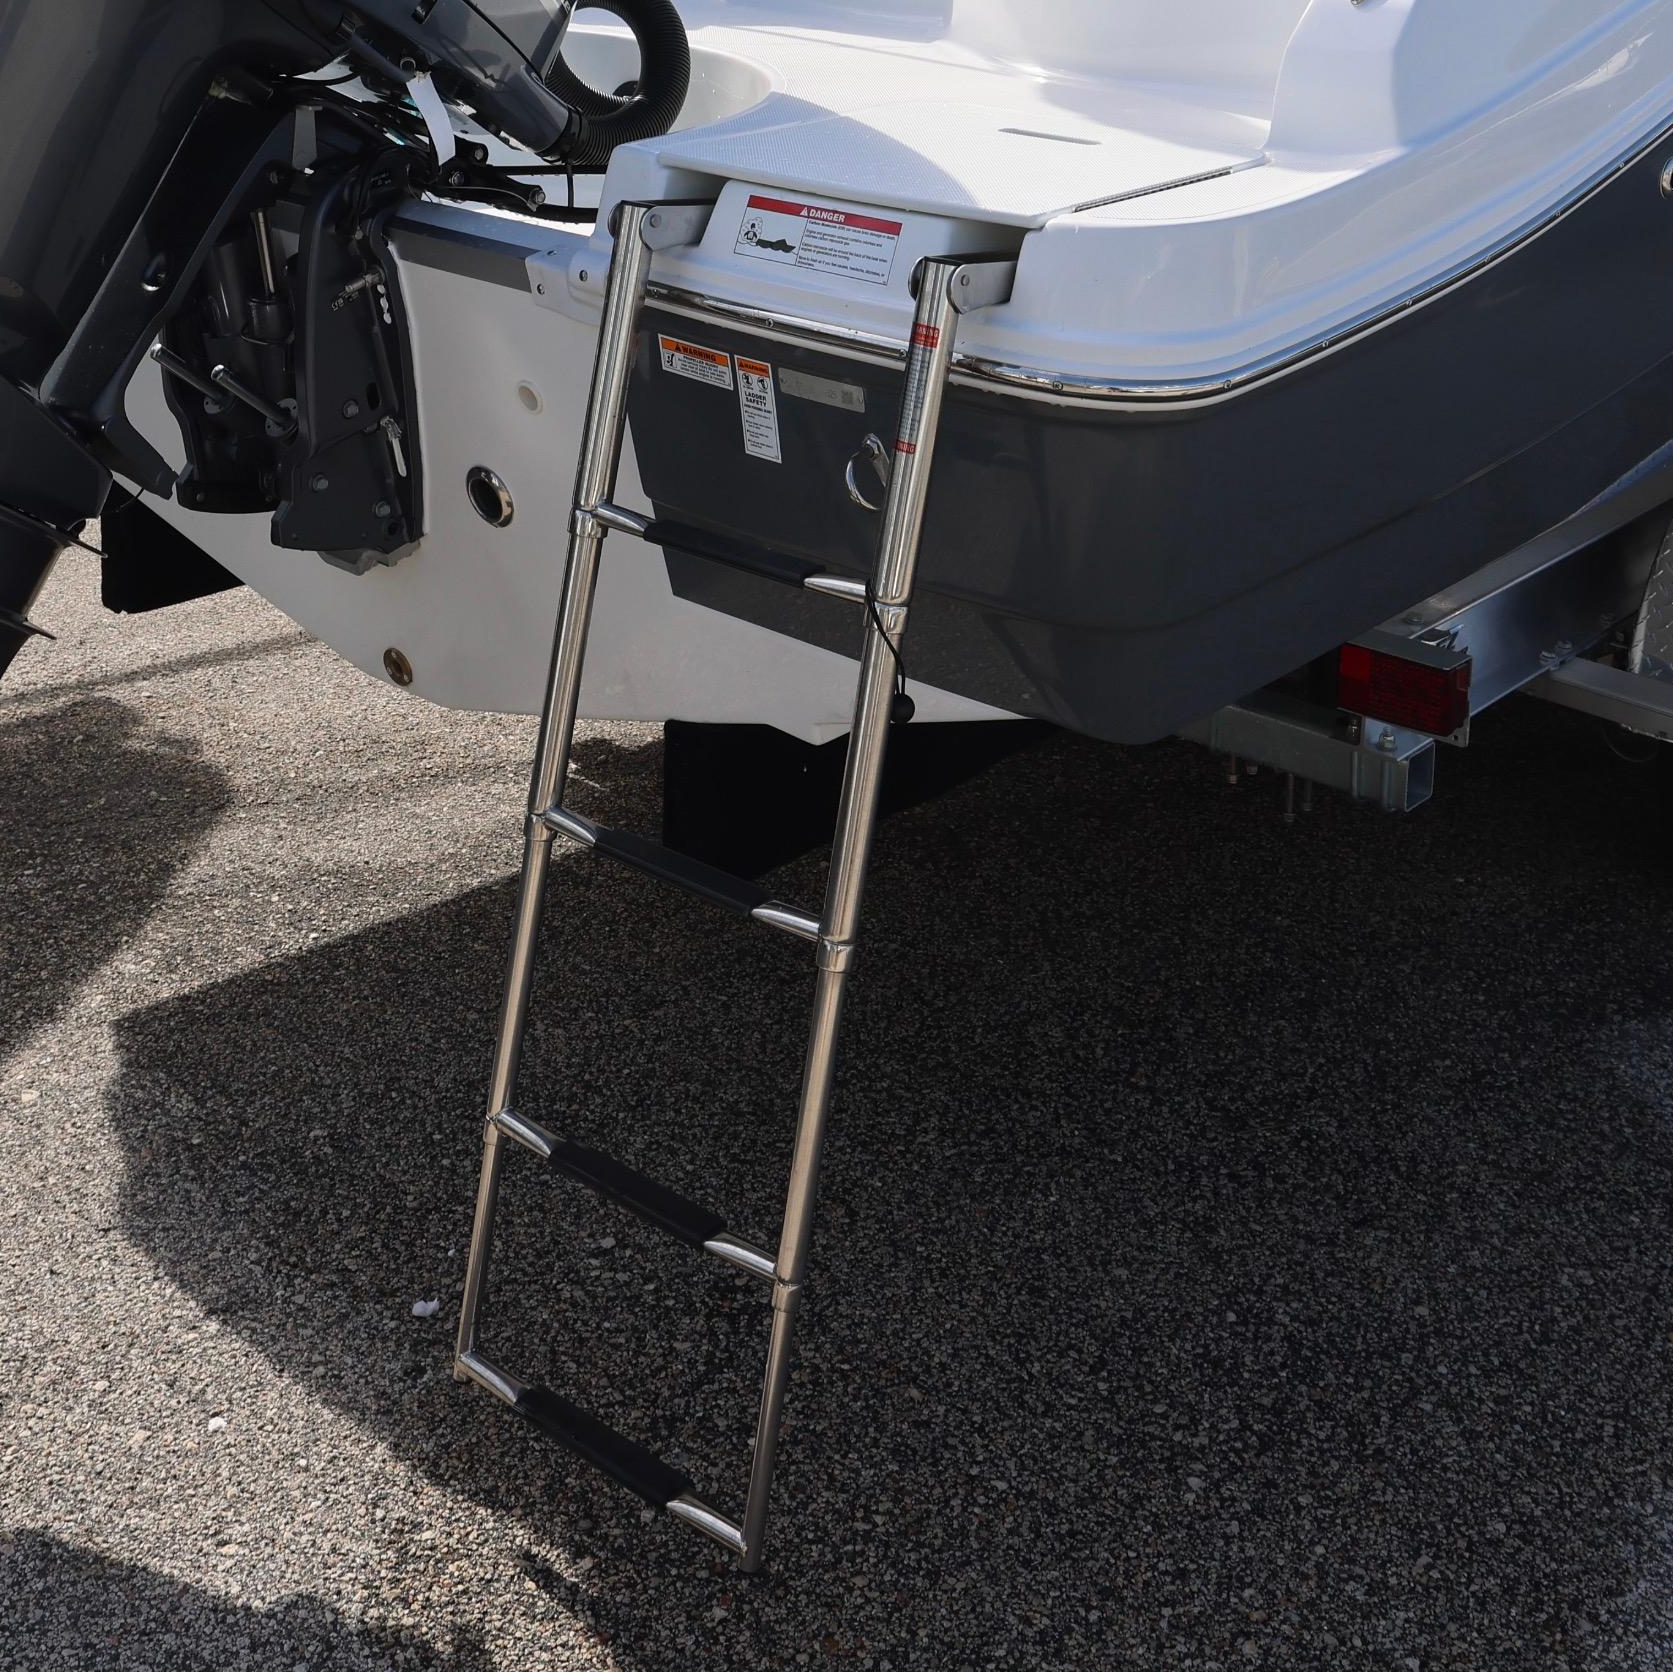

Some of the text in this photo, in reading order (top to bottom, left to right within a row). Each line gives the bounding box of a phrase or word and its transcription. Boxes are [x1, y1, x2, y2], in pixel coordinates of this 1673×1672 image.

[809, 208, 846, 223] DANGER
[681, 343, 717, 362] WARNING
[744, 390, 767, 401] LADDER
[745, 396, 767, 407] SAFETY
